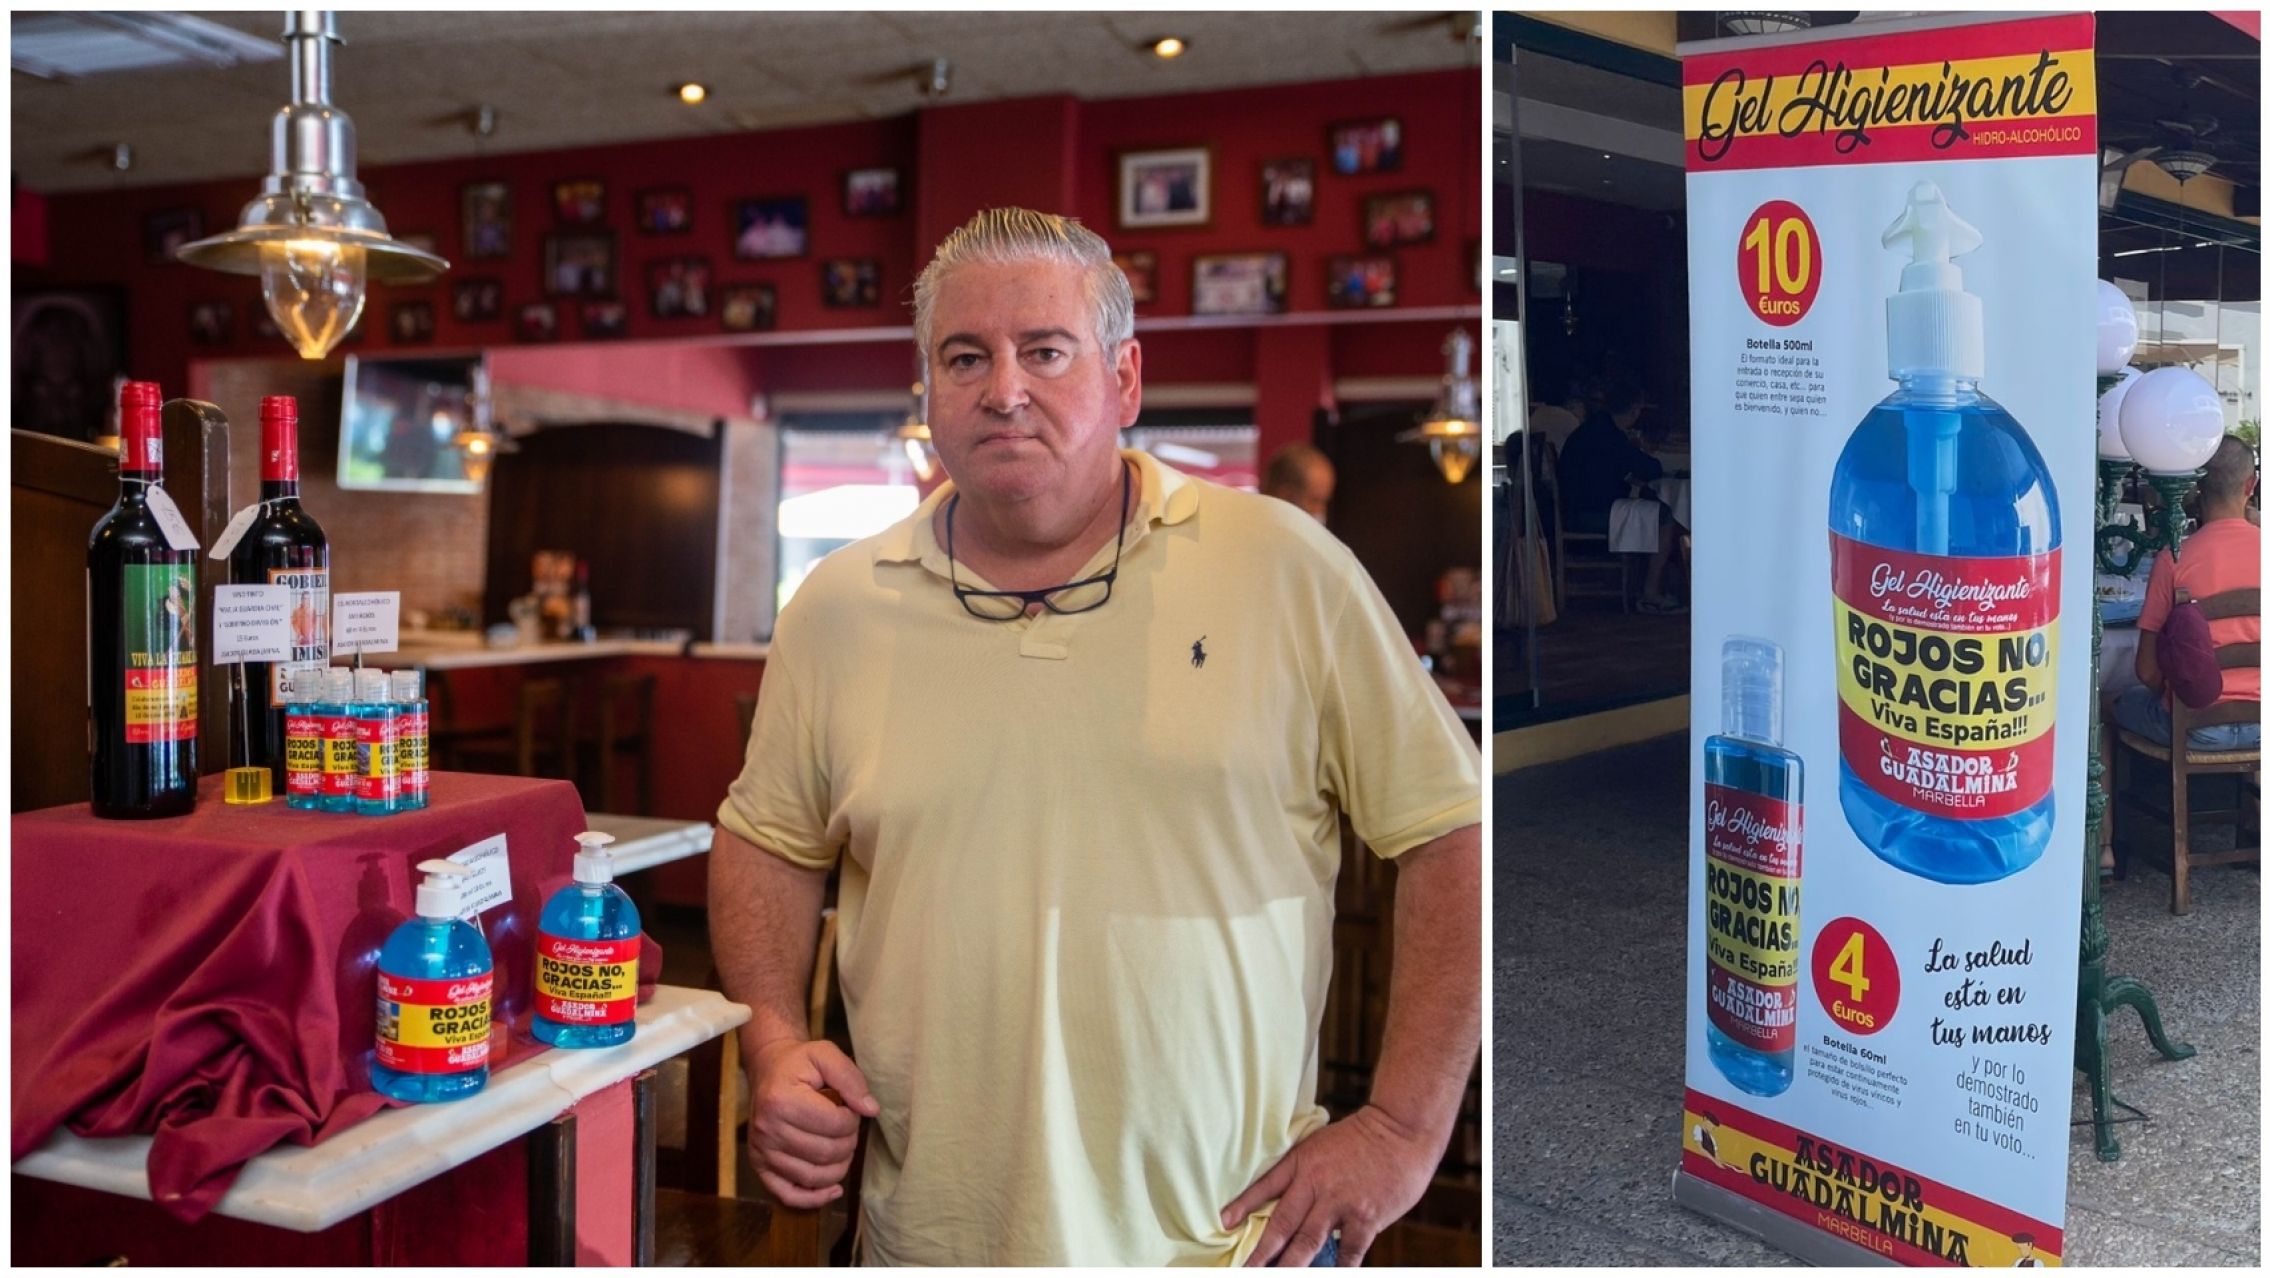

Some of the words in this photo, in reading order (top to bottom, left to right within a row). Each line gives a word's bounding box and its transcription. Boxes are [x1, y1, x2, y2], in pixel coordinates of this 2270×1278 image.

[1699, 68, 1773, 161] Gel
[1779, 49, 2072, 154] Higienizante
[1973, 127, 2081, 146] HIDRO-ALCOHÓLICO
[1745, 217, 1811, 294] 10
[1747, 338, 1780, 350] Botella
[1783, 340, 1812, 351] 500ml
[1737, 367, 1762, 376] entrada
[1771, 368, 1803, 378] recepción
[1804, 369, 1813, 378] de
[1814, 371, 1824, 379] su
[1749, 354, 1776, 364] formato
[1795, 357, 1810, 366] para
[1735, 391, 1747, 400] que
[1749, 392, 1769, 401] quien
[1806, 395, 1827, 404] quien
[1808, 383, 1825, 392] para
[1790, 406, 1809, 415] quien
[1870, 562, 1905, 598] Gel
[1907, 569, 2031, 611] Higienizante
[1881, 598, 1895, 612] La
[1898, 605, 1927, 618] salud
[1953, 614, 1965, 622] en
[1969, 611, 1985, 623] tus
[1986, 613, 2017, 622] manos
[1847, 610, 1984, 675] ROJOS
[1997, 632, 2050, 674] NO,
[1853, 654, 2046, 715] GRACIAS...
[1871, 699, 1917, 733] Viva
[1925, 714, 2028, 745] España!!!
[1907, 747, 1992, 776] ASADOR
[1912, 786, 1985, 808] MARBELLA
[1708, 800, 1728, 831] Gel
[1708, 862, 1773, 914] ROJOS
[1709, 934, 1735, 964] Viva
[1924, 937, 1959, 973] La
[1964, 939, 2033, 971] salud
[543, 958, 593, 977] ROJOS
[599, 965, 625, 978] NO,
[543, 972, 622, 990] GRACIAS...
[1828, 931, 1870, 1002] 4
[549, 986, 567, 997] Viva
[1727, 977, 1782, 1007] ASADOR
[1944, 977, 1991, 1011] está
[1996, 985, 2026, 1005] en
[430, 1001, 487, 1021] ROJOS
[1730, 1016, 1778, 1039] MARBELLA
[1930, 1017, 1966, 1048] tus
[1972, 1023, 2052, 1045] manos
[1823, 1035, 1858, 1055] Botella
[1860, 1048, 1887, 1065] 60ml
[1808, 1068, 1840, 1086] protegido
[1841, 1079, 1850, 1089] de
[1852, 1084, 1869, 1096] virus
[1809, 1058, 1825, 1069] para
[1827, 1063, 1845, 1075] estar
[1846, 1071, 1900, 1094] continuamente
[1840, 1056, 1848, 1066] de
[1850, 1060, 1876, 1075] bolsillo
[1877, 1069, 1908, 1085] perfecto
[1972, 1055, 1980, 1074] y
[1984, 1059, 2008, 1079] por
[2011, 1063, 2025, 1084] lo
[1956, 1071, 2039, 1114] demostrado
[1968, 1096, 2024, 1132] también
[1955, 1117, 1971, 1136] en
[1975, 1126, 1989, 1143] tu
[1993, 1133, 2036, 1160] voto...
[1794, 1135, 1924, 1213] ASADOR
[1817, 1212, 1893, 1256] MARBELLA
